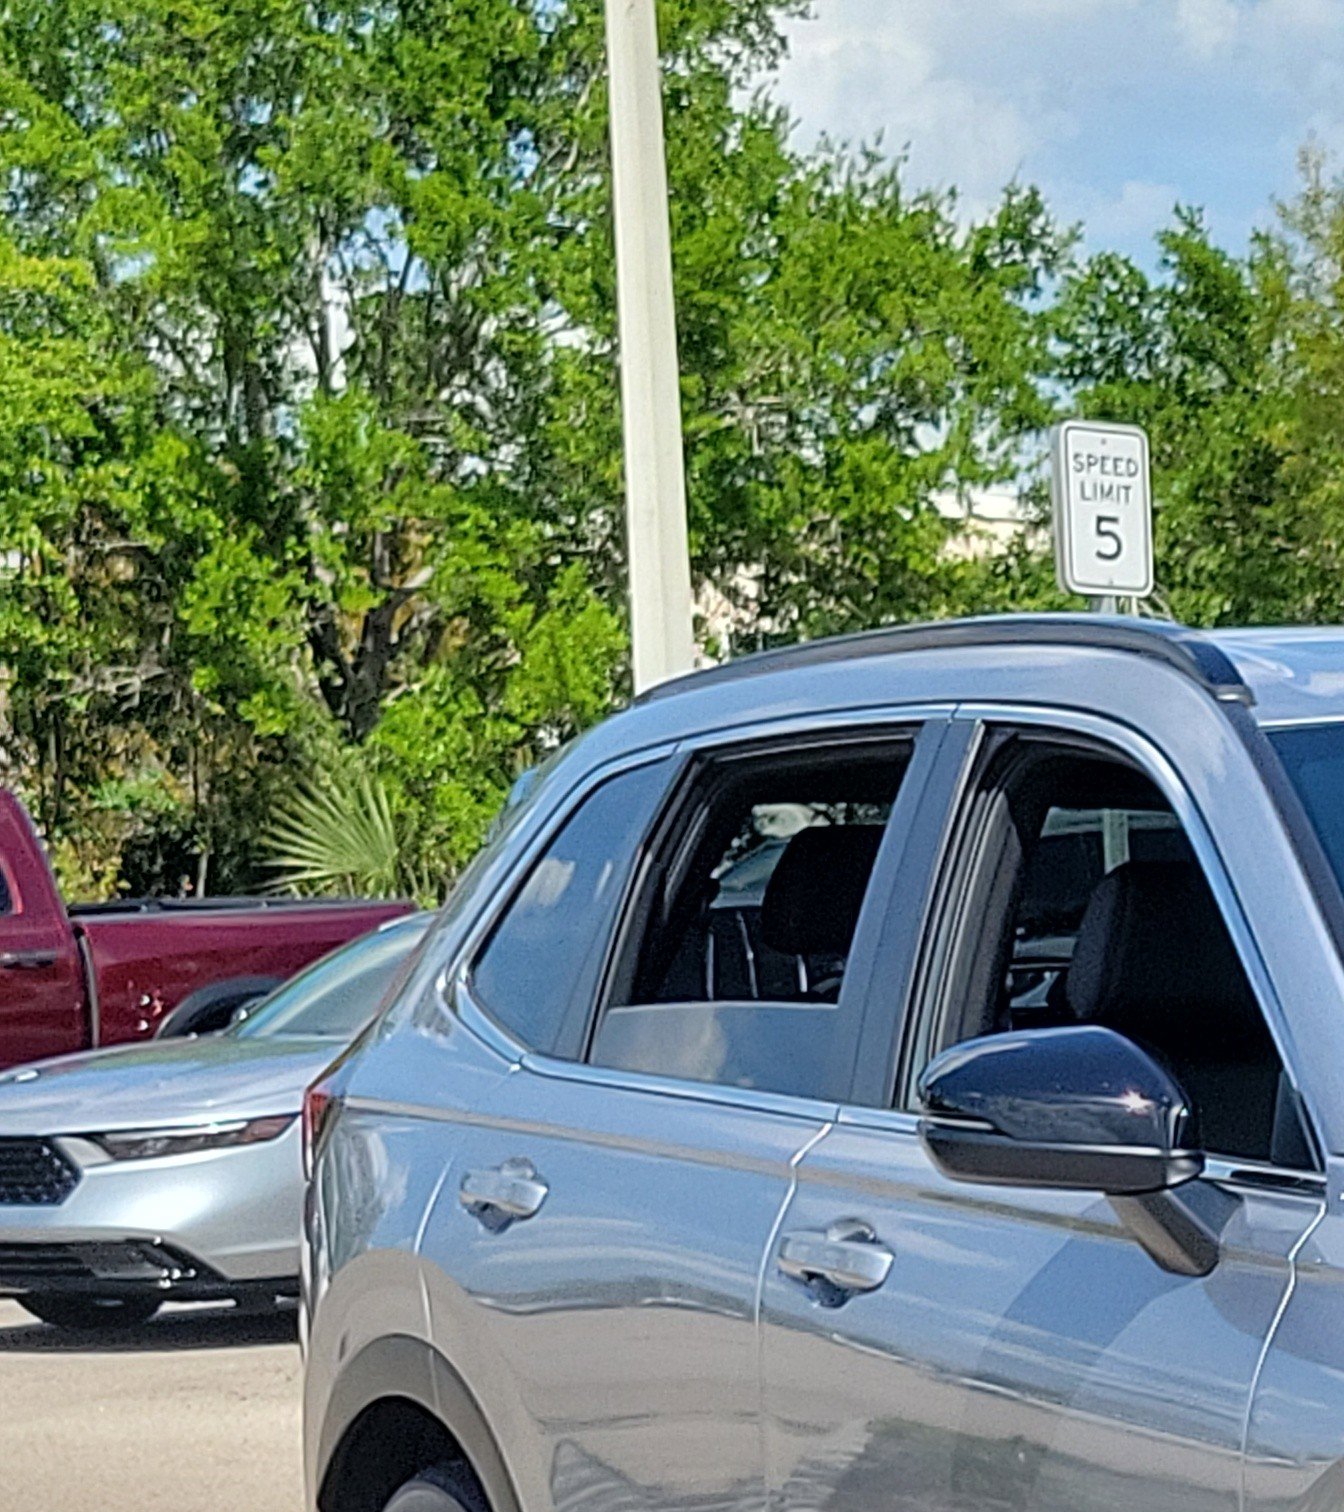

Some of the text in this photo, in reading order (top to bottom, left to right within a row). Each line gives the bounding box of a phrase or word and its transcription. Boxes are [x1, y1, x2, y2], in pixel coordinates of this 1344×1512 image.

[1072, 453, 1139, 478] SPEED
[1080, 481, 1132, 504] LIMIT
[1095, 515, 1123, 561] 5
